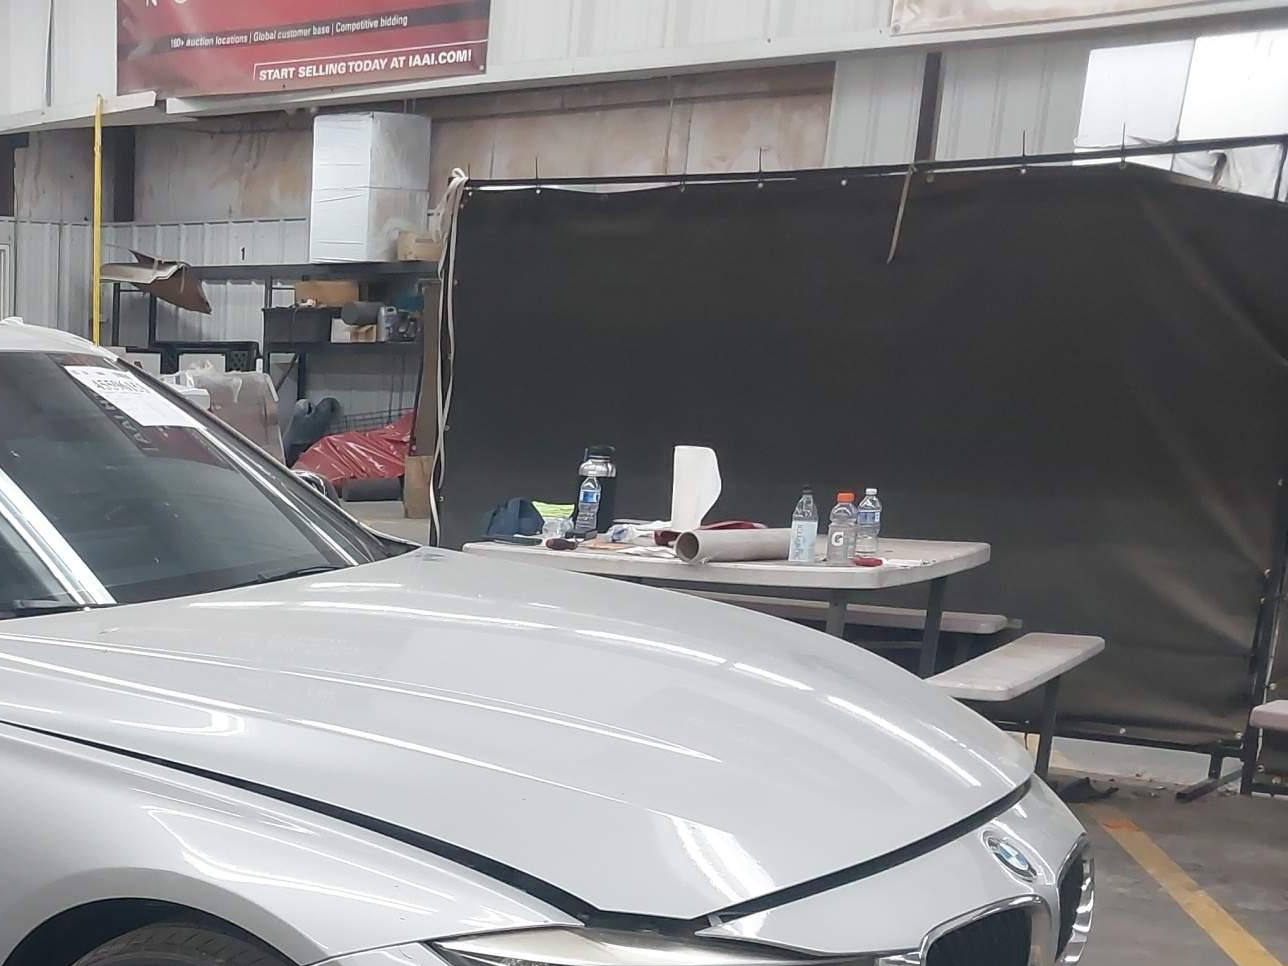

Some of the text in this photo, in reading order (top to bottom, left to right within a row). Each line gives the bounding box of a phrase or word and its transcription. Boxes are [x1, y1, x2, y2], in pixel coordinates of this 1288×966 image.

[185, 36, 214, 48] auction
[215, 34, 248, 46] locations
[253, 29, 277, 42] Global
[277, 27, 312, 39] customer
[312, 24, 330, 36] base
[335, 18, 379, 33] Competitive
[380, 14, 408, 28] bidding
[259, 49, 473, 81] START SELLING TODAY AT IAAI.COM!
